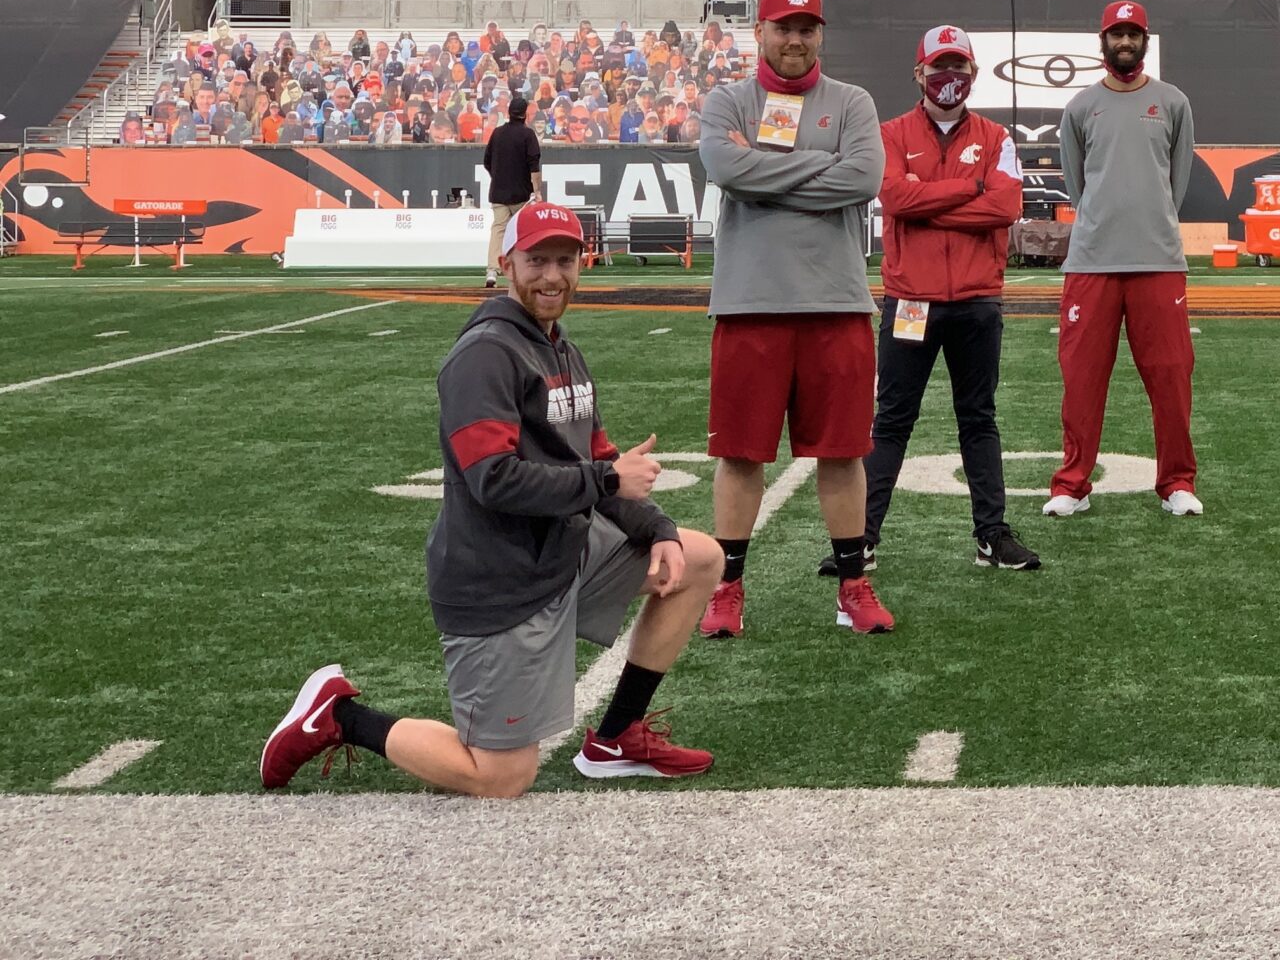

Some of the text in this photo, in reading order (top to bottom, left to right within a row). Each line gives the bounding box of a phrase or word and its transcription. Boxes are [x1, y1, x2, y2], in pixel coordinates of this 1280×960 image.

[133, 201, 184, 211] GATORADE
[321, 215, 337, 223] BIG
[396, 214, 412, 222] BIG
[468, 214, 484, 223] BIG
[535, 208, 569, 222] WSU
